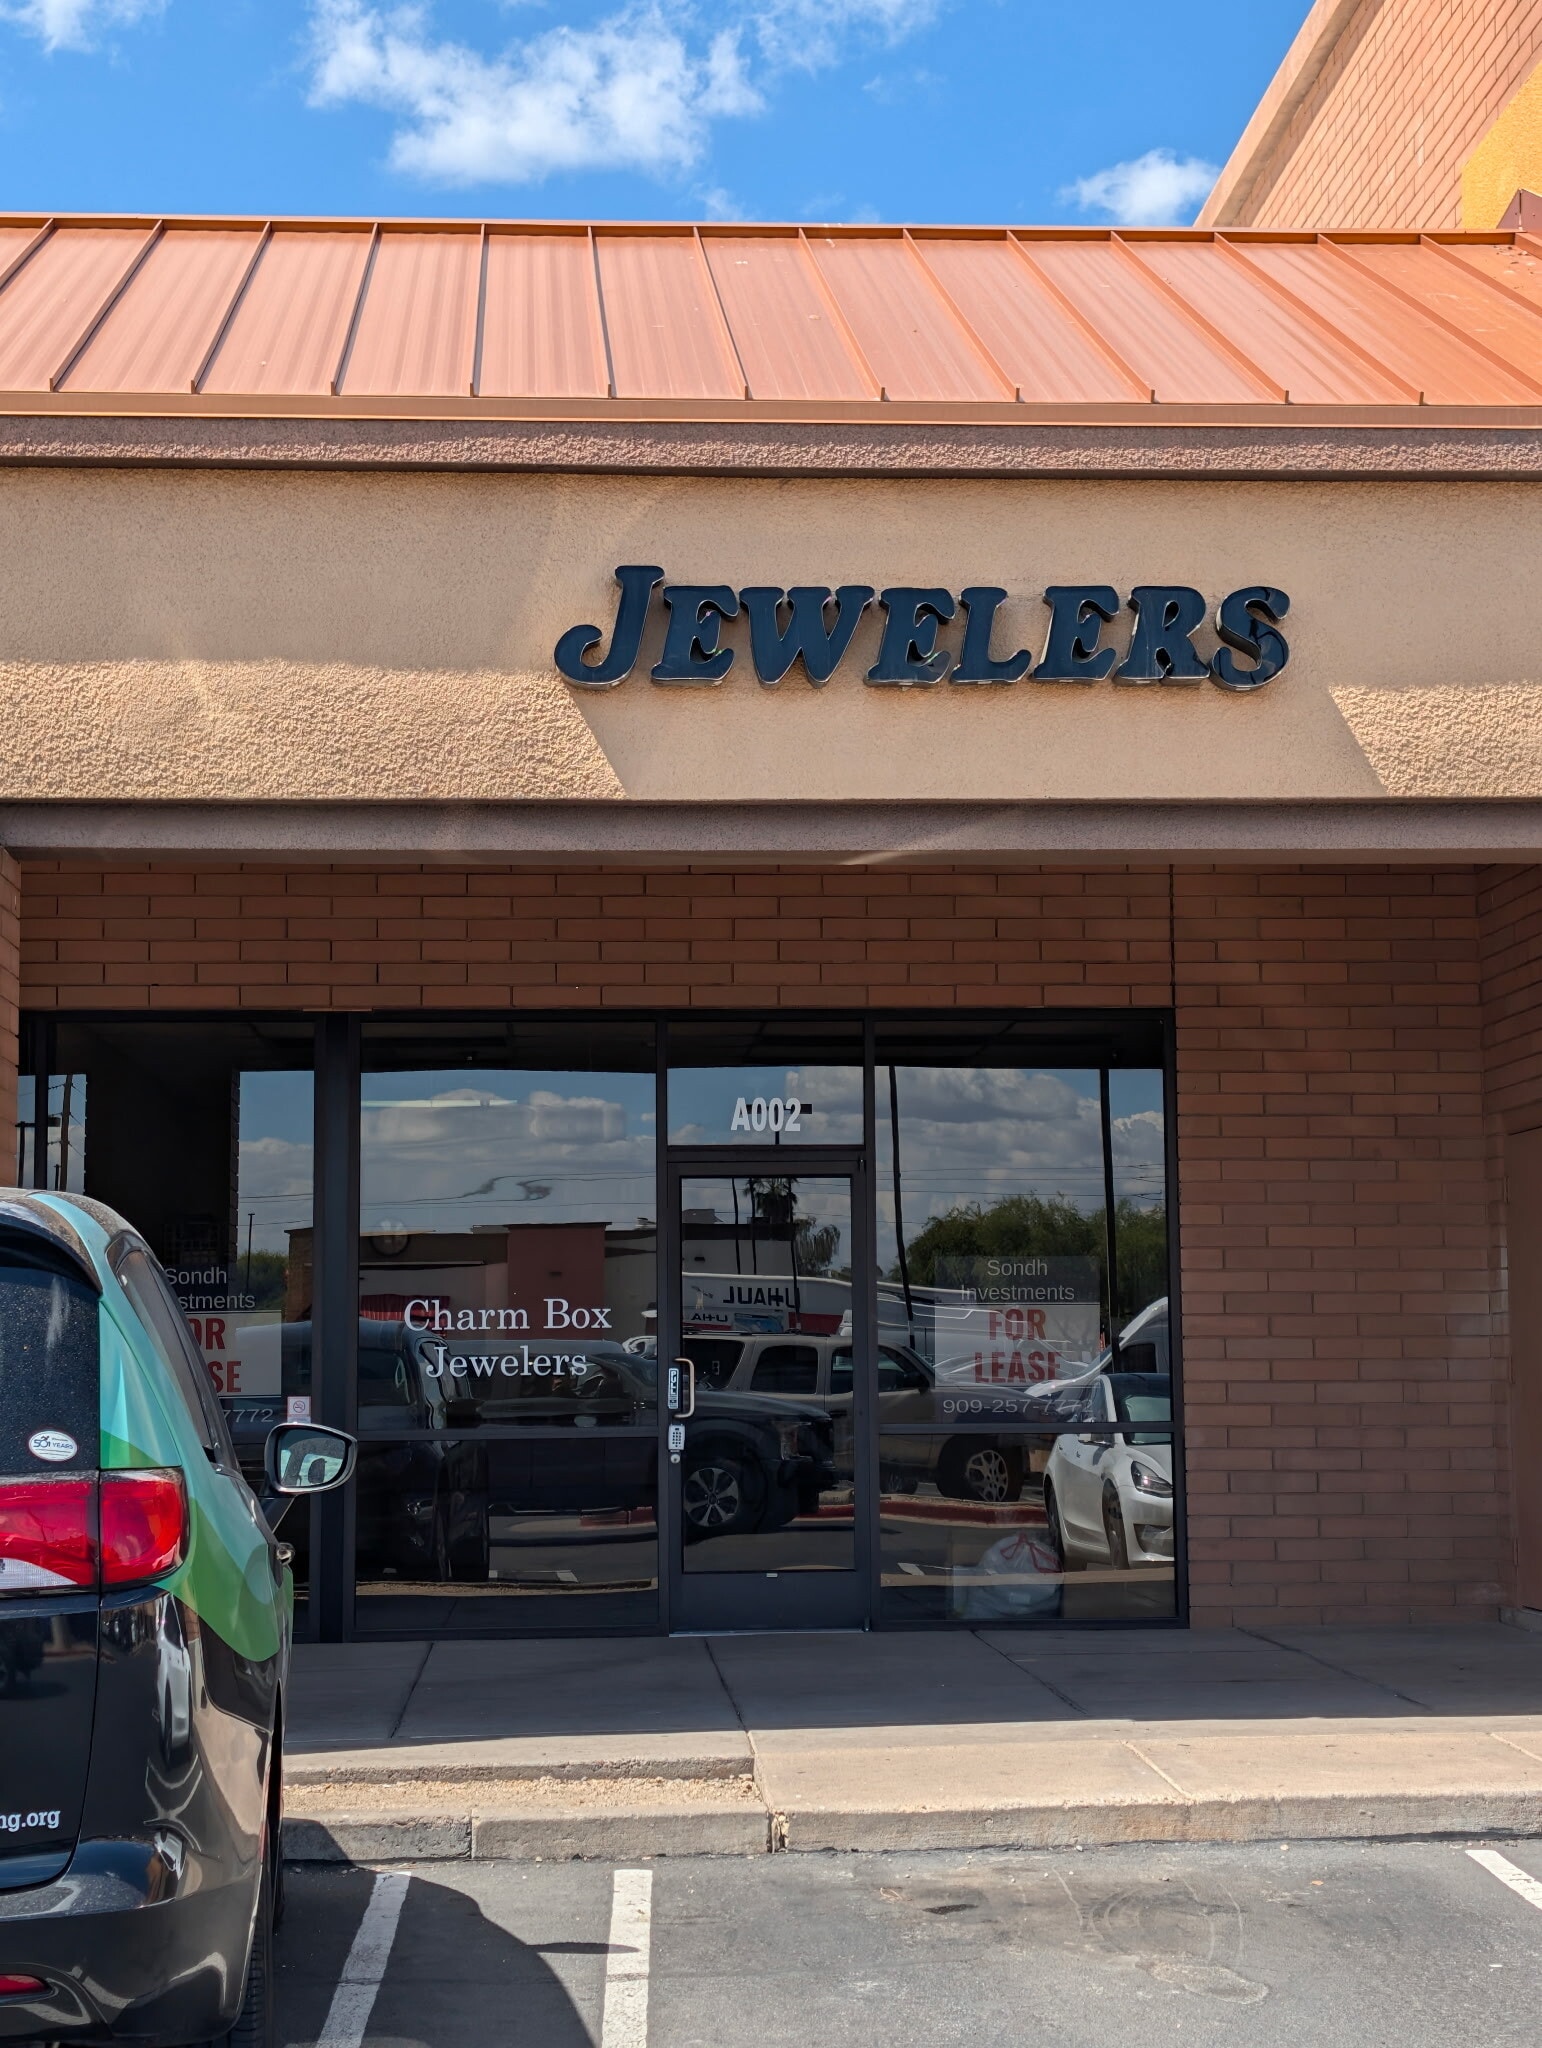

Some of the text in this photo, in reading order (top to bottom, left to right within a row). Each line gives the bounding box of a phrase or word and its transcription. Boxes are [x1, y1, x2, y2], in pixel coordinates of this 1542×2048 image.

[731, 1097, 801, 1132] A002
[165, 1267, 228, 1285] Sondh
[987, 1259, 1048, 1276] Sondh
[177, 1293, 256, 1310] stments
[961, 1284, 1075, 1301] Investments
[404, 1298, 612, 1331] Charm Box
[989, 1308, 1047, 1341] FOR
[425, 1345, 588, 1378] Jewelers
[974, 1351, 1062, 1384] LEASE
